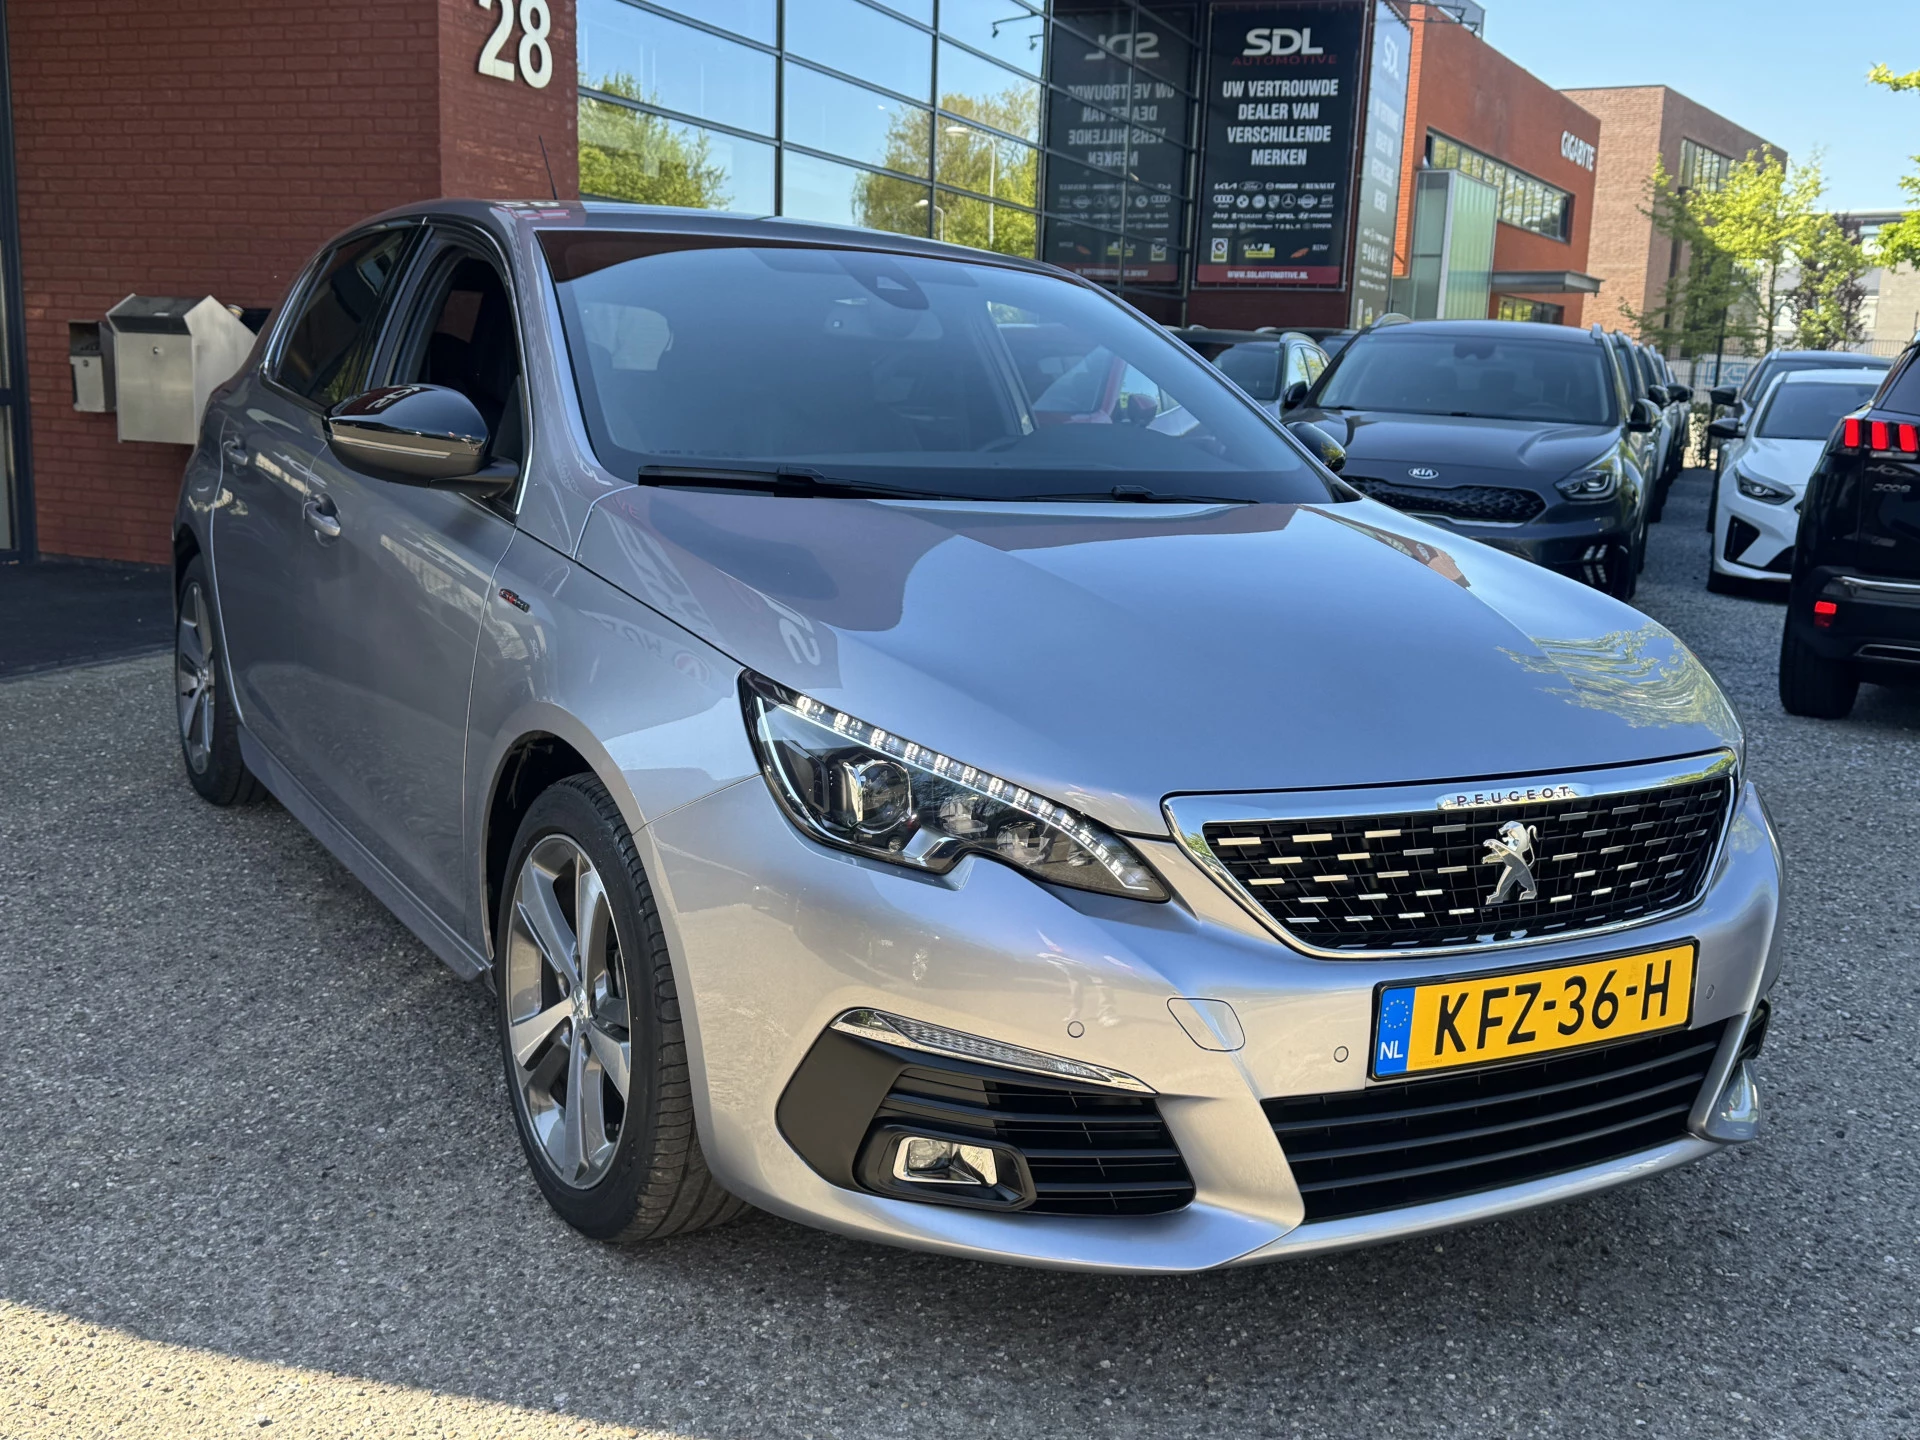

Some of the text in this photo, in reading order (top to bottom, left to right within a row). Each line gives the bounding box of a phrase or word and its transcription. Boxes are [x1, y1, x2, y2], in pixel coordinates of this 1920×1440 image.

[478, 0, 552, 88] 28
[1242, 28, 1323, 55] SDL
[1231, 54, 1337, 66] AUTOMOTIVE
[1222, 79, 1339, 97] UW VERTROUWDE
[1238, 102, 1319, 120] DEALER VAN
[1227, 125, 1332, 143] VERSCHILLENDE
[1251, 148, 1307, 165] MERKEN
[1561, 130, 1595, 172] GIGABYTE
[1412, 467, 1434, 477] KIA
[1456, 786, 1569, 806] PEUGEOT
[1434, 959, 1672, 1056] KFZ-36-H
[1380, 1040, 1404, 1061] NL
